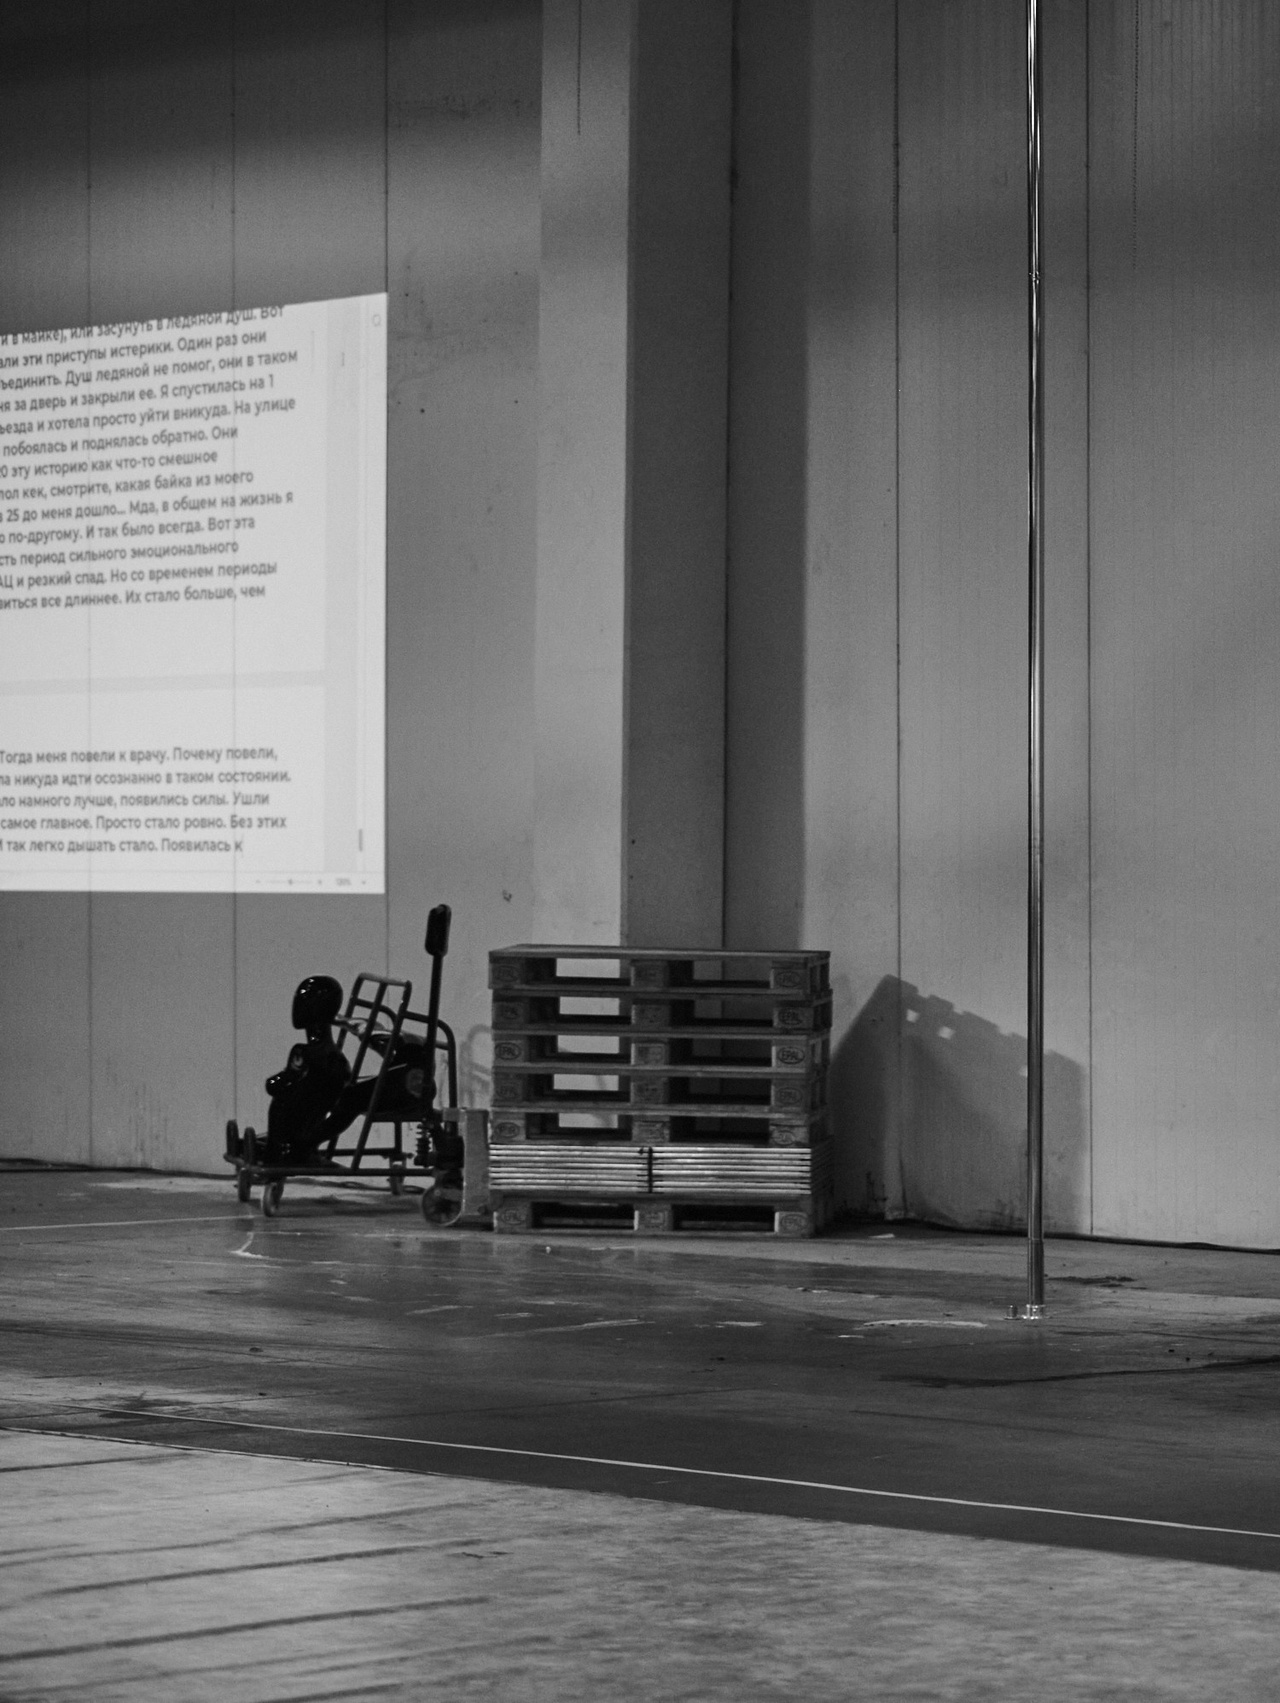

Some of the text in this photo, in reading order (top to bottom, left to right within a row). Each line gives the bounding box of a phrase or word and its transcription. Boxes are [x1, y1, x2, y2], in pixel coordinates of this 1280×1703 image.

[22, 353, 43, 367] эти
[45, 348, 107, 367] приступы
[110, 341, 174, 359] истерики.
[176, 336, 213, 353] Один
[215, 333, 239, 351] раз
[241, 331, 267, 345] они
[64, 369, 93, 388] Душ
[95, 362, 150, 382] ледяной
[153, 363, 169, 376] не
[172, 359, 216, 376] помог,
[218, 356, 243, 370] они
[246, 355, 255, 368] в
[257, 350, 298, 365] таком
[14, 399, 27, 412] за
[29, 396, 67, 412] дверь
[70, 395, 79, 407] и
[81, 390, 136, 407] закрыли
[138, 388, 157, 401] ее.
[160, 383, 169, 399] Я
[171, 380, 246, 400] спустилась
[249, 377, 265, 390] на
[36, 420, 45, 432] и
[47, 416, 90, 431] хотела
[92, 412, 137, 430] просто
[139, 407, 170, 427] уйти
[173, 404, 231, 421] вникуда.
[233, 400, 251, 415] На
[254, 398, 296, 417] улице
[2, 425, 238, 457] побоялась и поднялась обратно. Они
[11, 465, 31, 481] эту
[34, 461, 89, 478] историю
[90, 459, 113, 472] как
[115, 456, 156, 470] что-то
[158, 451, 218, 467] смешное
[22, 487, 48, 500] кек,
[49, 482, 112, 498] смотрите,
[115, 479, 151, 493] какая
[154, 474, 193, 490] байка
[195, 474, 212, 487] из
[214, 471, 254, 485] моего
[6, 508, 20, 523] 25
[21, 509, 38, 523] до
[41, 507, 73, 520] меня
[74, 504, 126, 520] дошло...
[129, 500, 159, 515] Мда,
[161, 500, 170, 513] в
[172, 495, 217, 512] общем
[220, 495, 237, 508] на
[239, 493, 283, 507] жизнь
[285, 491, 293, 503] я
[8, 529, 83, 546] по-другому.
[85, 525, 95, 539] И
[97, 526, 118, 538] так
[121, 521, 155, 537] было
[158, 520, 205, 535] всегда.
[207, 516, 232, 532] Вот
[234, 517, 255, 530] эта
[19, 551, 67, 568] период
[68, 548, 127, 563] сильного
[130, 541, 239, 559] эмоционального
[16, 576, 25, 588] и
[27, 570, 72, 590] резкий
[74, 572, 107, 586] спад.
[110, 569, 128, 583] Но
[130, 570, 145, 582] со
[148, 566, 214, 583] временем
[217, 562, 277, 579] периоды
[40, 596, 62, 609] все
[64, 593, 122, 609] длиннее.
[125, 590, 141, 604] Их
[144, 590, 181, 603] стало
[183, 585, 237, 601] больше,
[240, 586, 266, 598] чем
[0, 746, 278, 766] Тогда меня повели к врачу. Почему повели,
[14, 774, 59, 789] никуда
[61, 773, 92, 787] идти
[94, 772, 162, 785] осознанно
[165, 772, 173, 785] в
[175, 772, 214, 784] таком
[217, 771, 291, 784] состоянии.
[18, 795, 71, 808] намного
[73, 795, 117, 810] лучше,
[120, 794, 189, 807] появились
[191, 794, 229, 806] силы.
[232, 791, 270, 806] Ушли
[0, 813, 287, 832] самое главное. Просто стало ровно. Без этих
[6, 840, 26, 852] так
[29, 840, 65, 852] легко
[66, 840, 116, 854] дышать
[118, 840, 158, 852] стало.
[161, 837, 232, 852] Появилась
[234, 840, 243, 852] к
